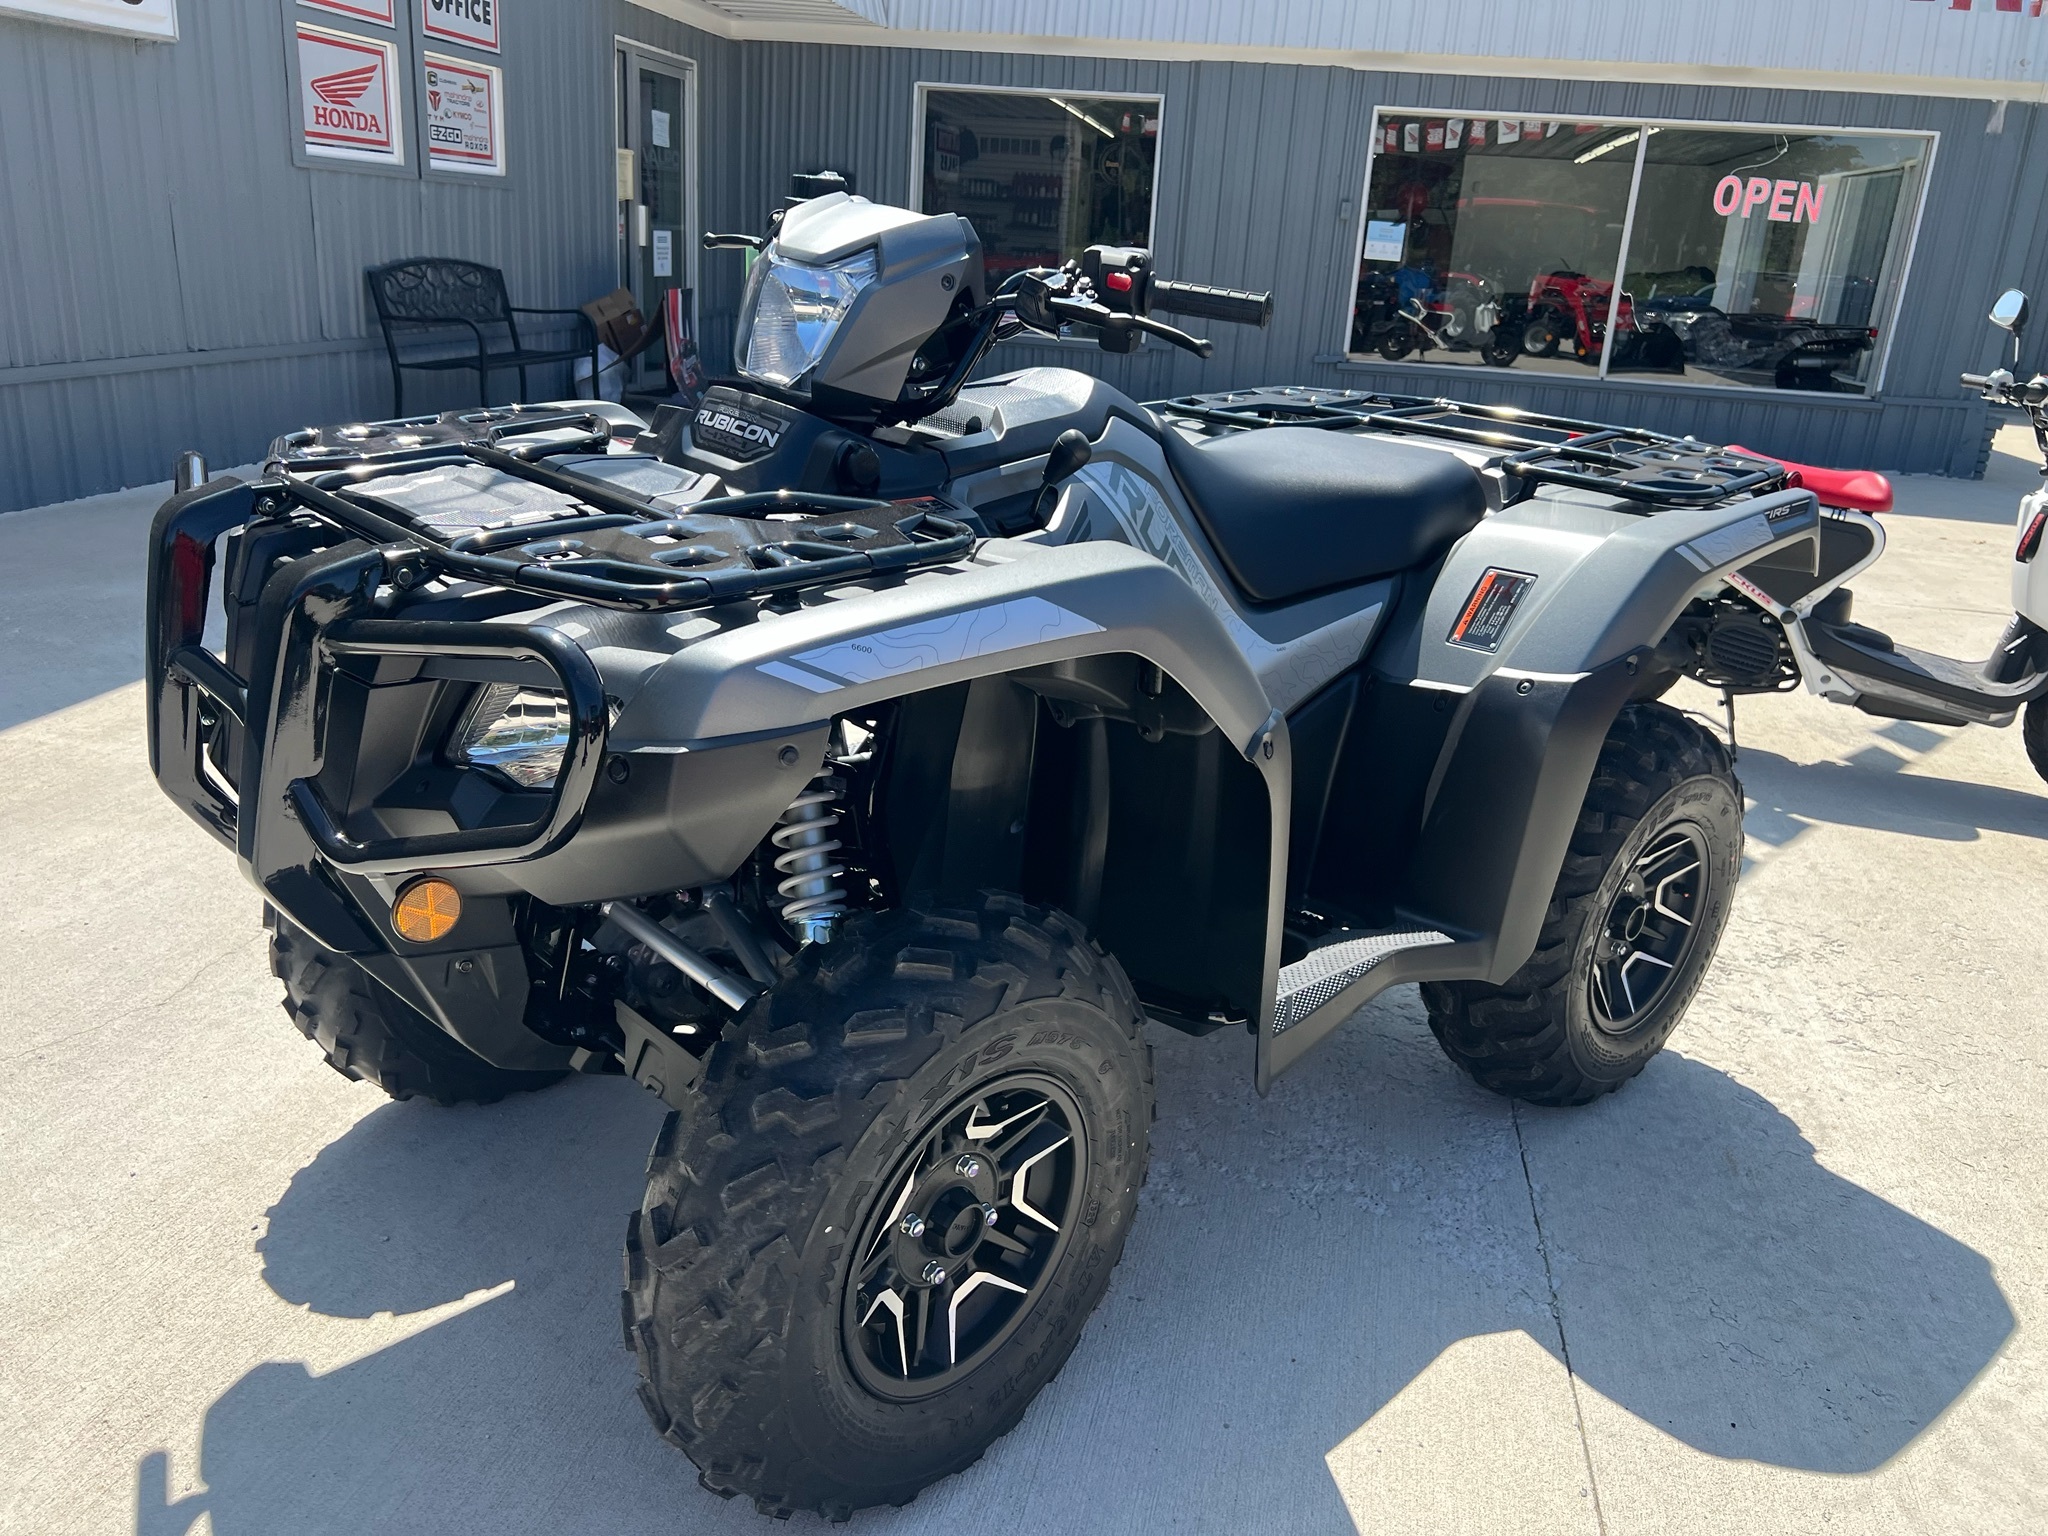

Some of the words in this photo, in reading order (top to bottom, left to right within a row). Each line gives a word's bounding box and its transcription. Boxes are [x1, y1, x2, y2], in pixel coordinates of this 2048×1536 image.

[446, 98, 471, 107] TRACTORS
[452, 111, 472, 121] KYMCO
[313, 105, 382, 133] HONDA
[464, 141, 489, 152] ROXOR
[1713, 175, 1827, 224] OPEN
[694, 409, 780, 448] RUBICON
[1769, 505, 1791, 519] IRS
[1143, 483, 1220, 611] FOREMAN
[1466, 585, 1488, 618] WARNING
[1728, 572, 1773, 606] CKUS
[851, 643, 873, 654] 6600
